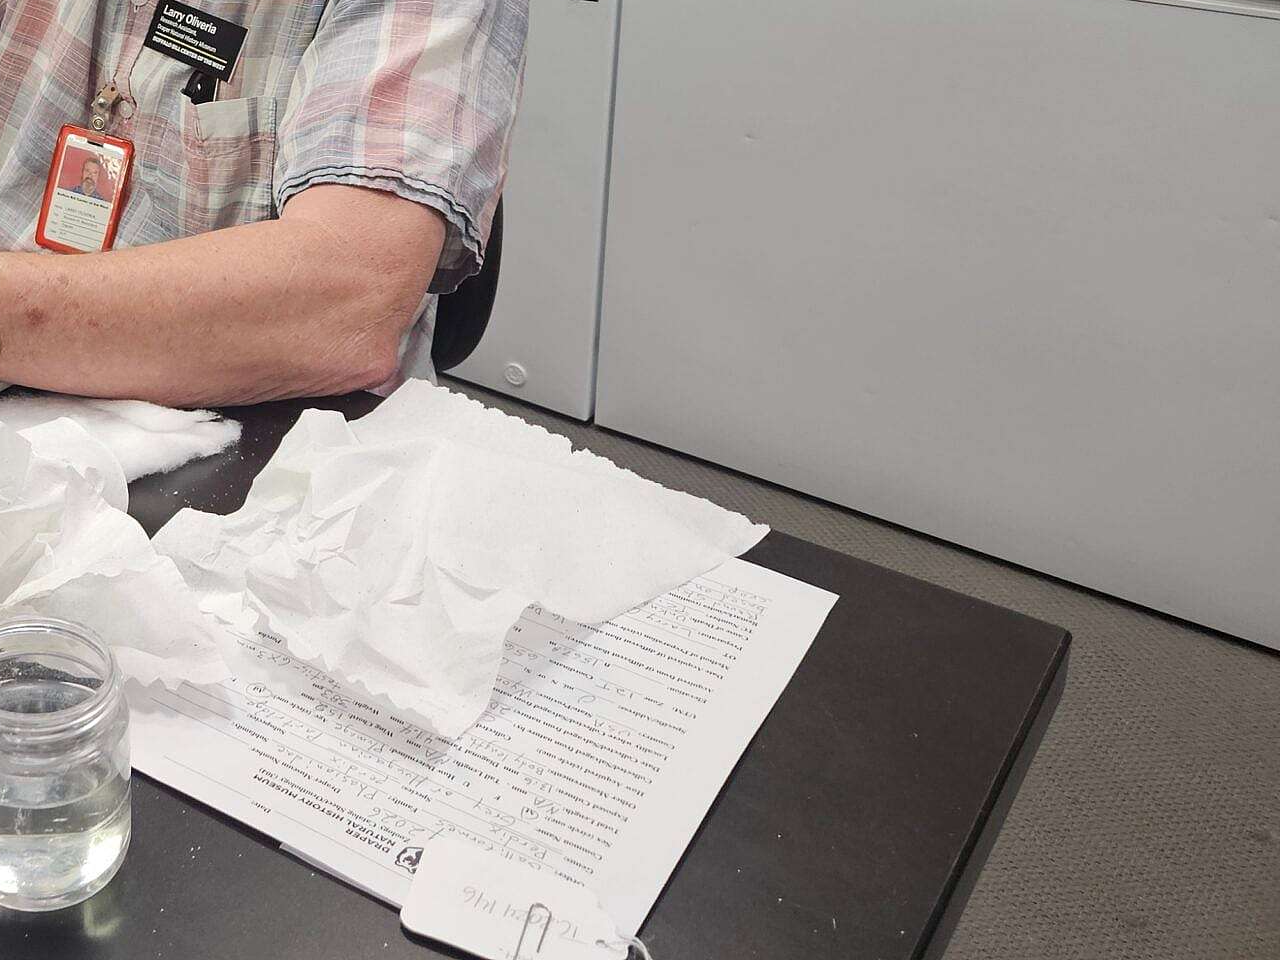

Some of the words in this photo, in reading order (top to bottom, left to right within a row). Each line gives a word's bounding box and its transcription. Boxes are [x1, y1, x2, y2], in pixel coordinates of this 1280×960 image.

[163, 5, 185, 22] Larry
[185, 14, 217, 34] Oliveria
[158, 24, 170, 34] Draper
[185, 34, 199, 46] History
[199, 40, 217, 52] Museum
[204, 56, 213, 64] THE
[212, 59, 226, 71] WEST
[656, 669, 675, 679] from
[353, 700, 378, 715] Weight:
[513, 695, 532, 706] from
[348, 714, 372, 726] Chord:
[542, 721, 561, 732] from
[374, 724, 393, 737] Wing
[475, 723, 511, 740] Collected
[554, 740, 573, 751] from
[389, 748, 435, 771] Determined:
[464, 749, 499, 767] Diagonal
[281, 761, 310, 779] Museum
[438, 769, 454, 780] How
[452, 760, 482, 776] Length:
[642, 761, 659, 772] Date
[315, 777, 340, 793] Draper
[483, 773, 499, 783] Tail
[547, 769, 606, 798] Measurements:
[583, 768, 619, 786] Acquired
[253, 774, 297, 798] MUSEUM
[401, 786, 430, 802] Species:
[625, 785, 644, 796] How
[248, 798, 273, 815] Date:
[300, 797, 343, 821] HISTORY
[387, 797, 417, 813] Family:
[612, 796, 636, 809] Other
[347, 810, 376, 827] Catalog
[592, 804, 628, 822] Exposed
[347, 820, 395, 846] NATURAL
[380, 825, 410, 842] Zoology
[590, 819, 617, 834] Total
[345, 828, 389, 852] DRAPER
[563, 839, 602, 860] Common
